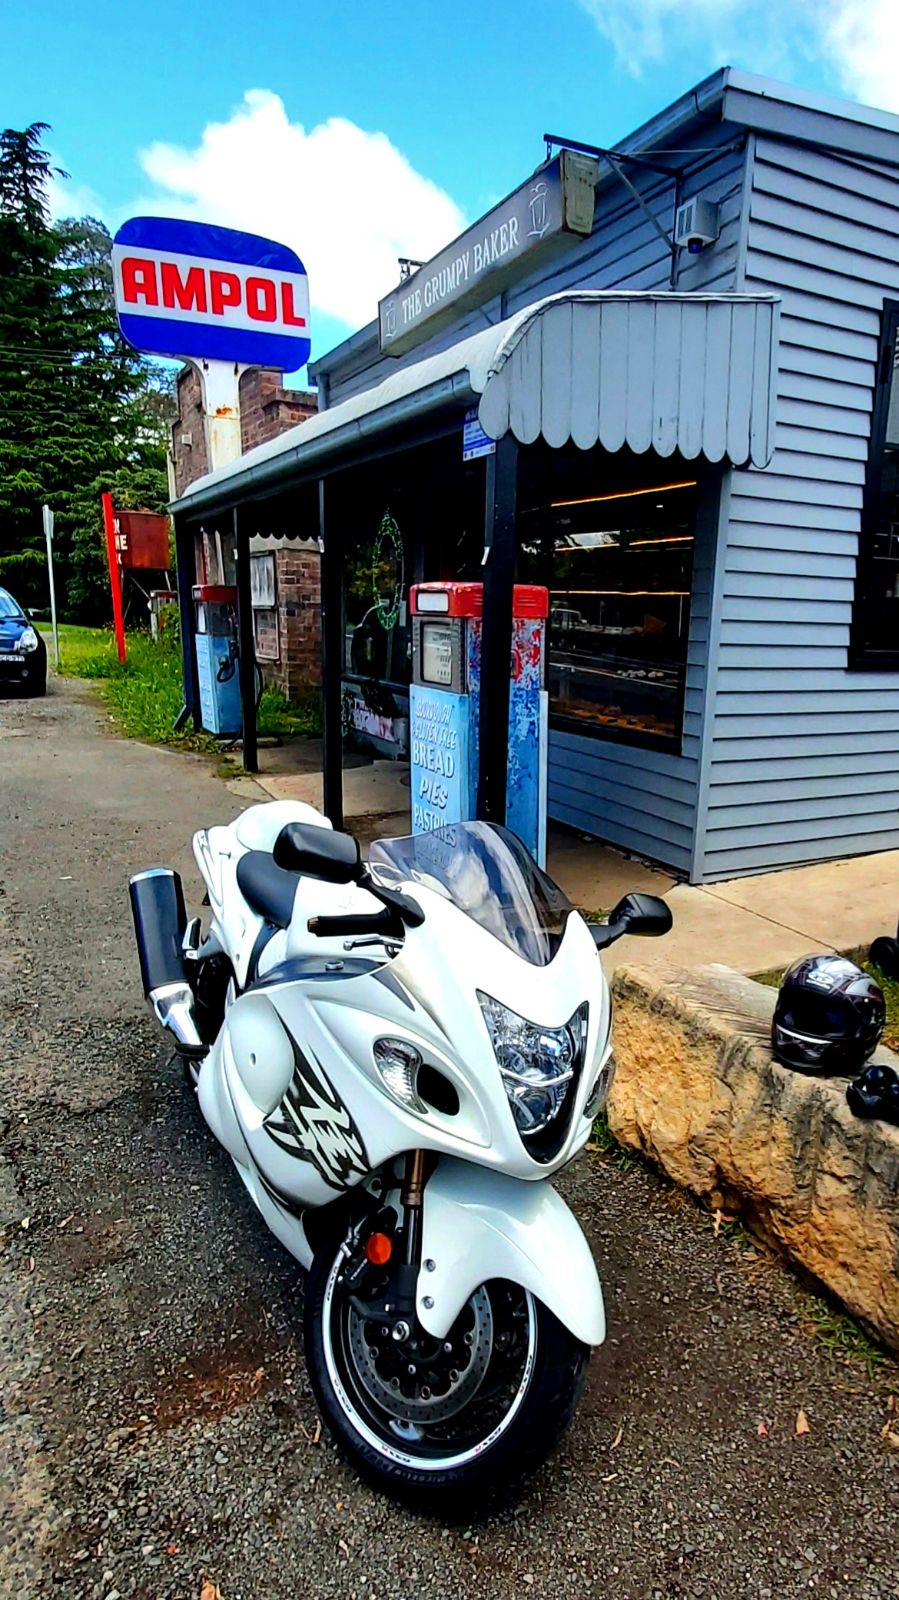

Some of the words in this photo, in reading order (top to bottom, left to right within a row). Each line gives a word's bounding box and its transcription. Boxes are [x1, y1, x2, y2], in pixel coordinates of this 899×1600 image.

[402, 290, 421, 324] THE
[424, 251, 470, 307] GRUMPY
[473, 217, 519, 274] BAKER
[121, 257, 305, 327] AMPOL
[439, 726, 457, 749] FREE
[413, 740, 455, 778] BREAD
[420, 777, 449, 809] PIES
[415, 803, 457, 848] PASTRIES
